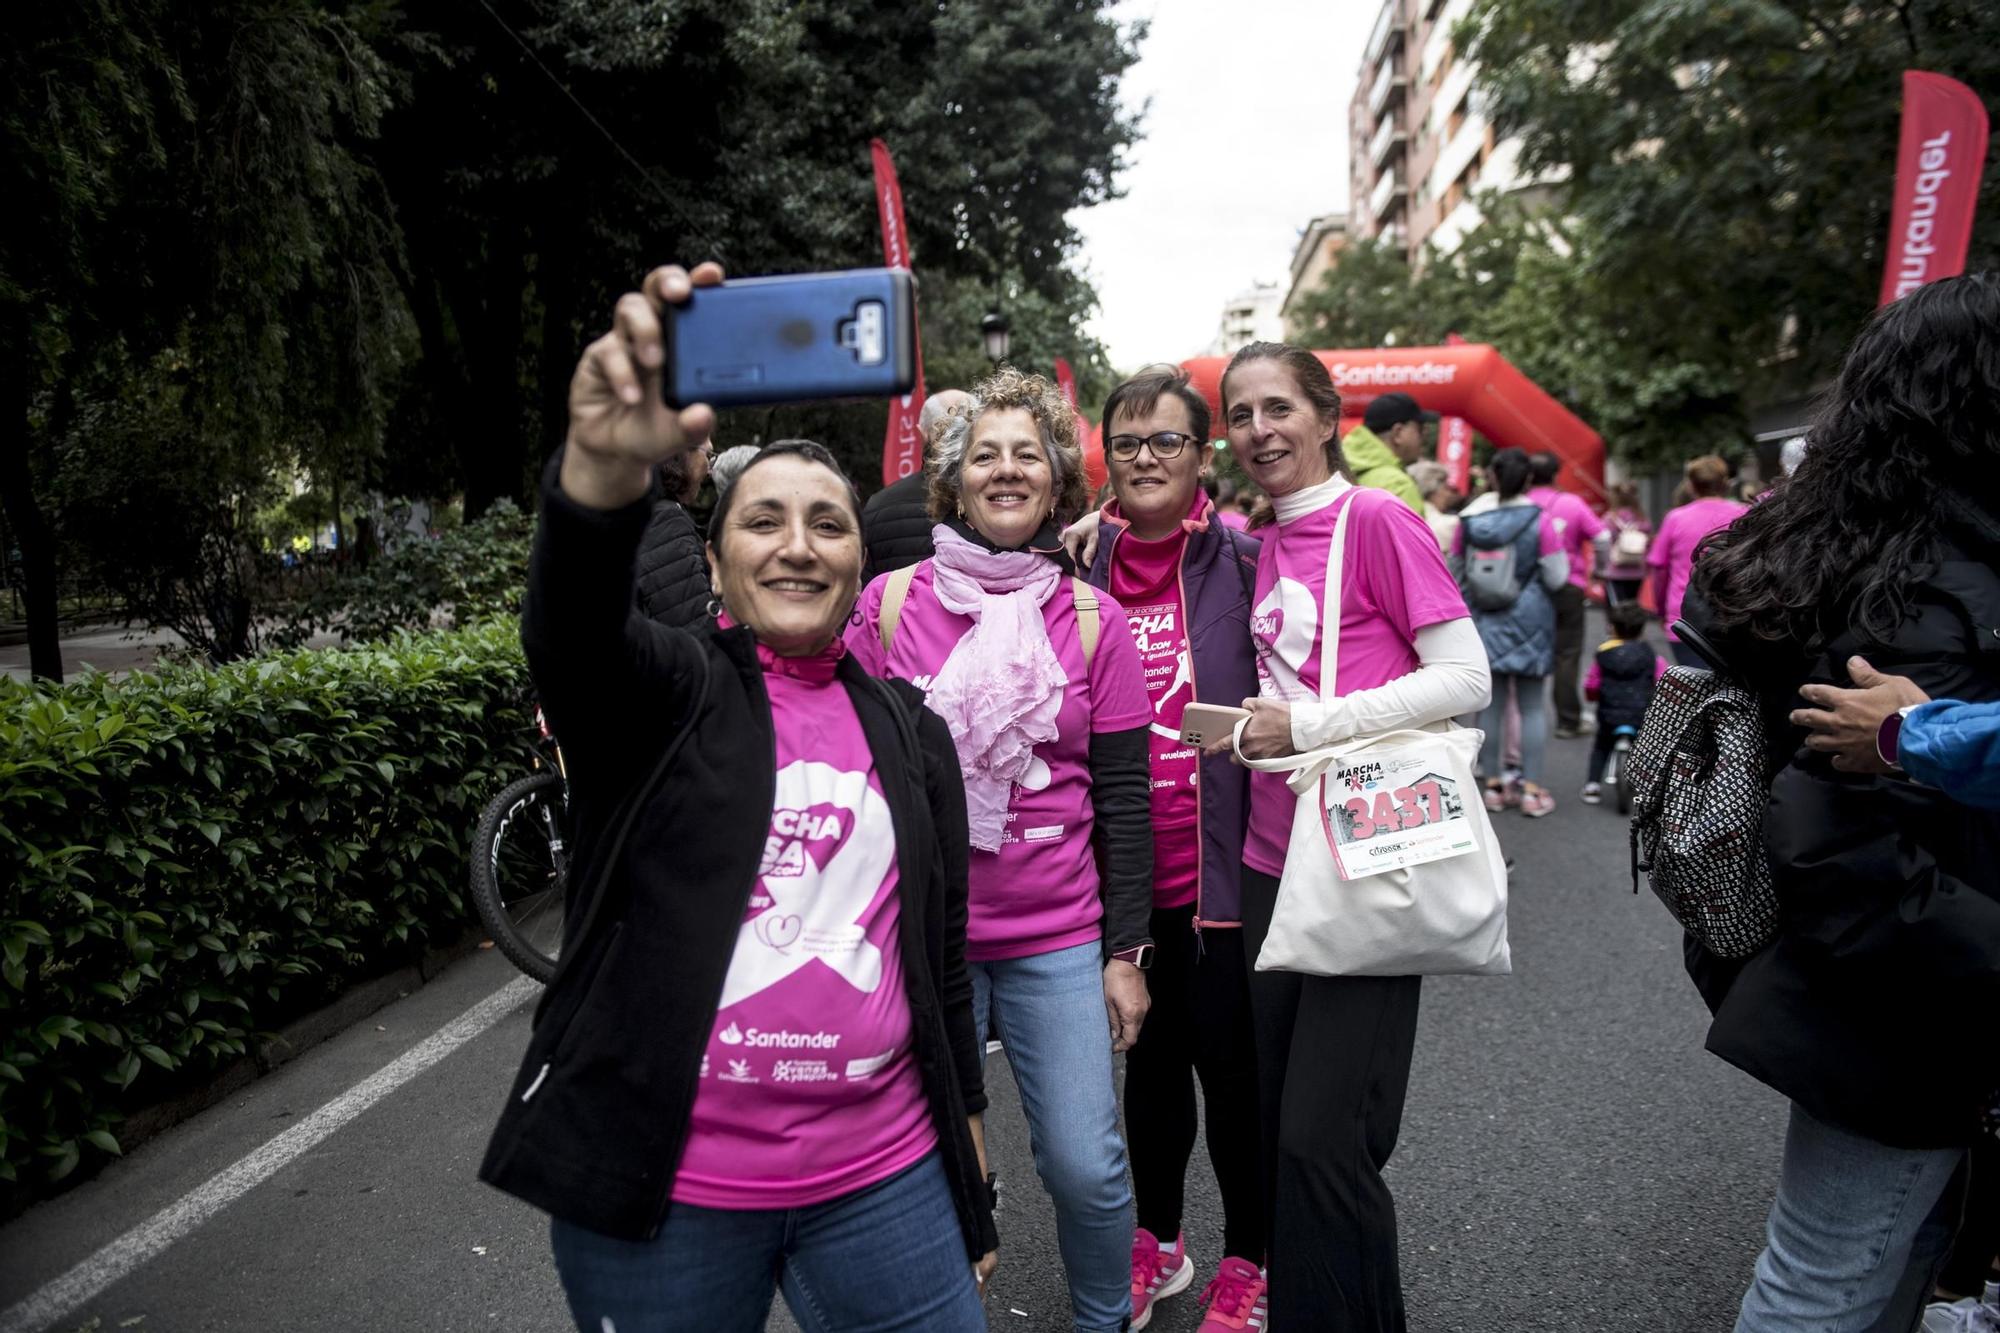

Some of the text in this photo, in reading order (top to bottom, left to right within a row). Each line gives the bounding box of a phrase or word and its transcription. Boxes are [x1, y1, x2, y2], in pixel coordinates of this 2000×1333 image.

[1331, 361, 1457, 386] Santander
[1336, 762, 1381, 780] MARCHA
[1345, 781, 1441, 839] 3437
[773, 811, 841, 840] CHA
[745, 1028, 840, 1049] Santander
